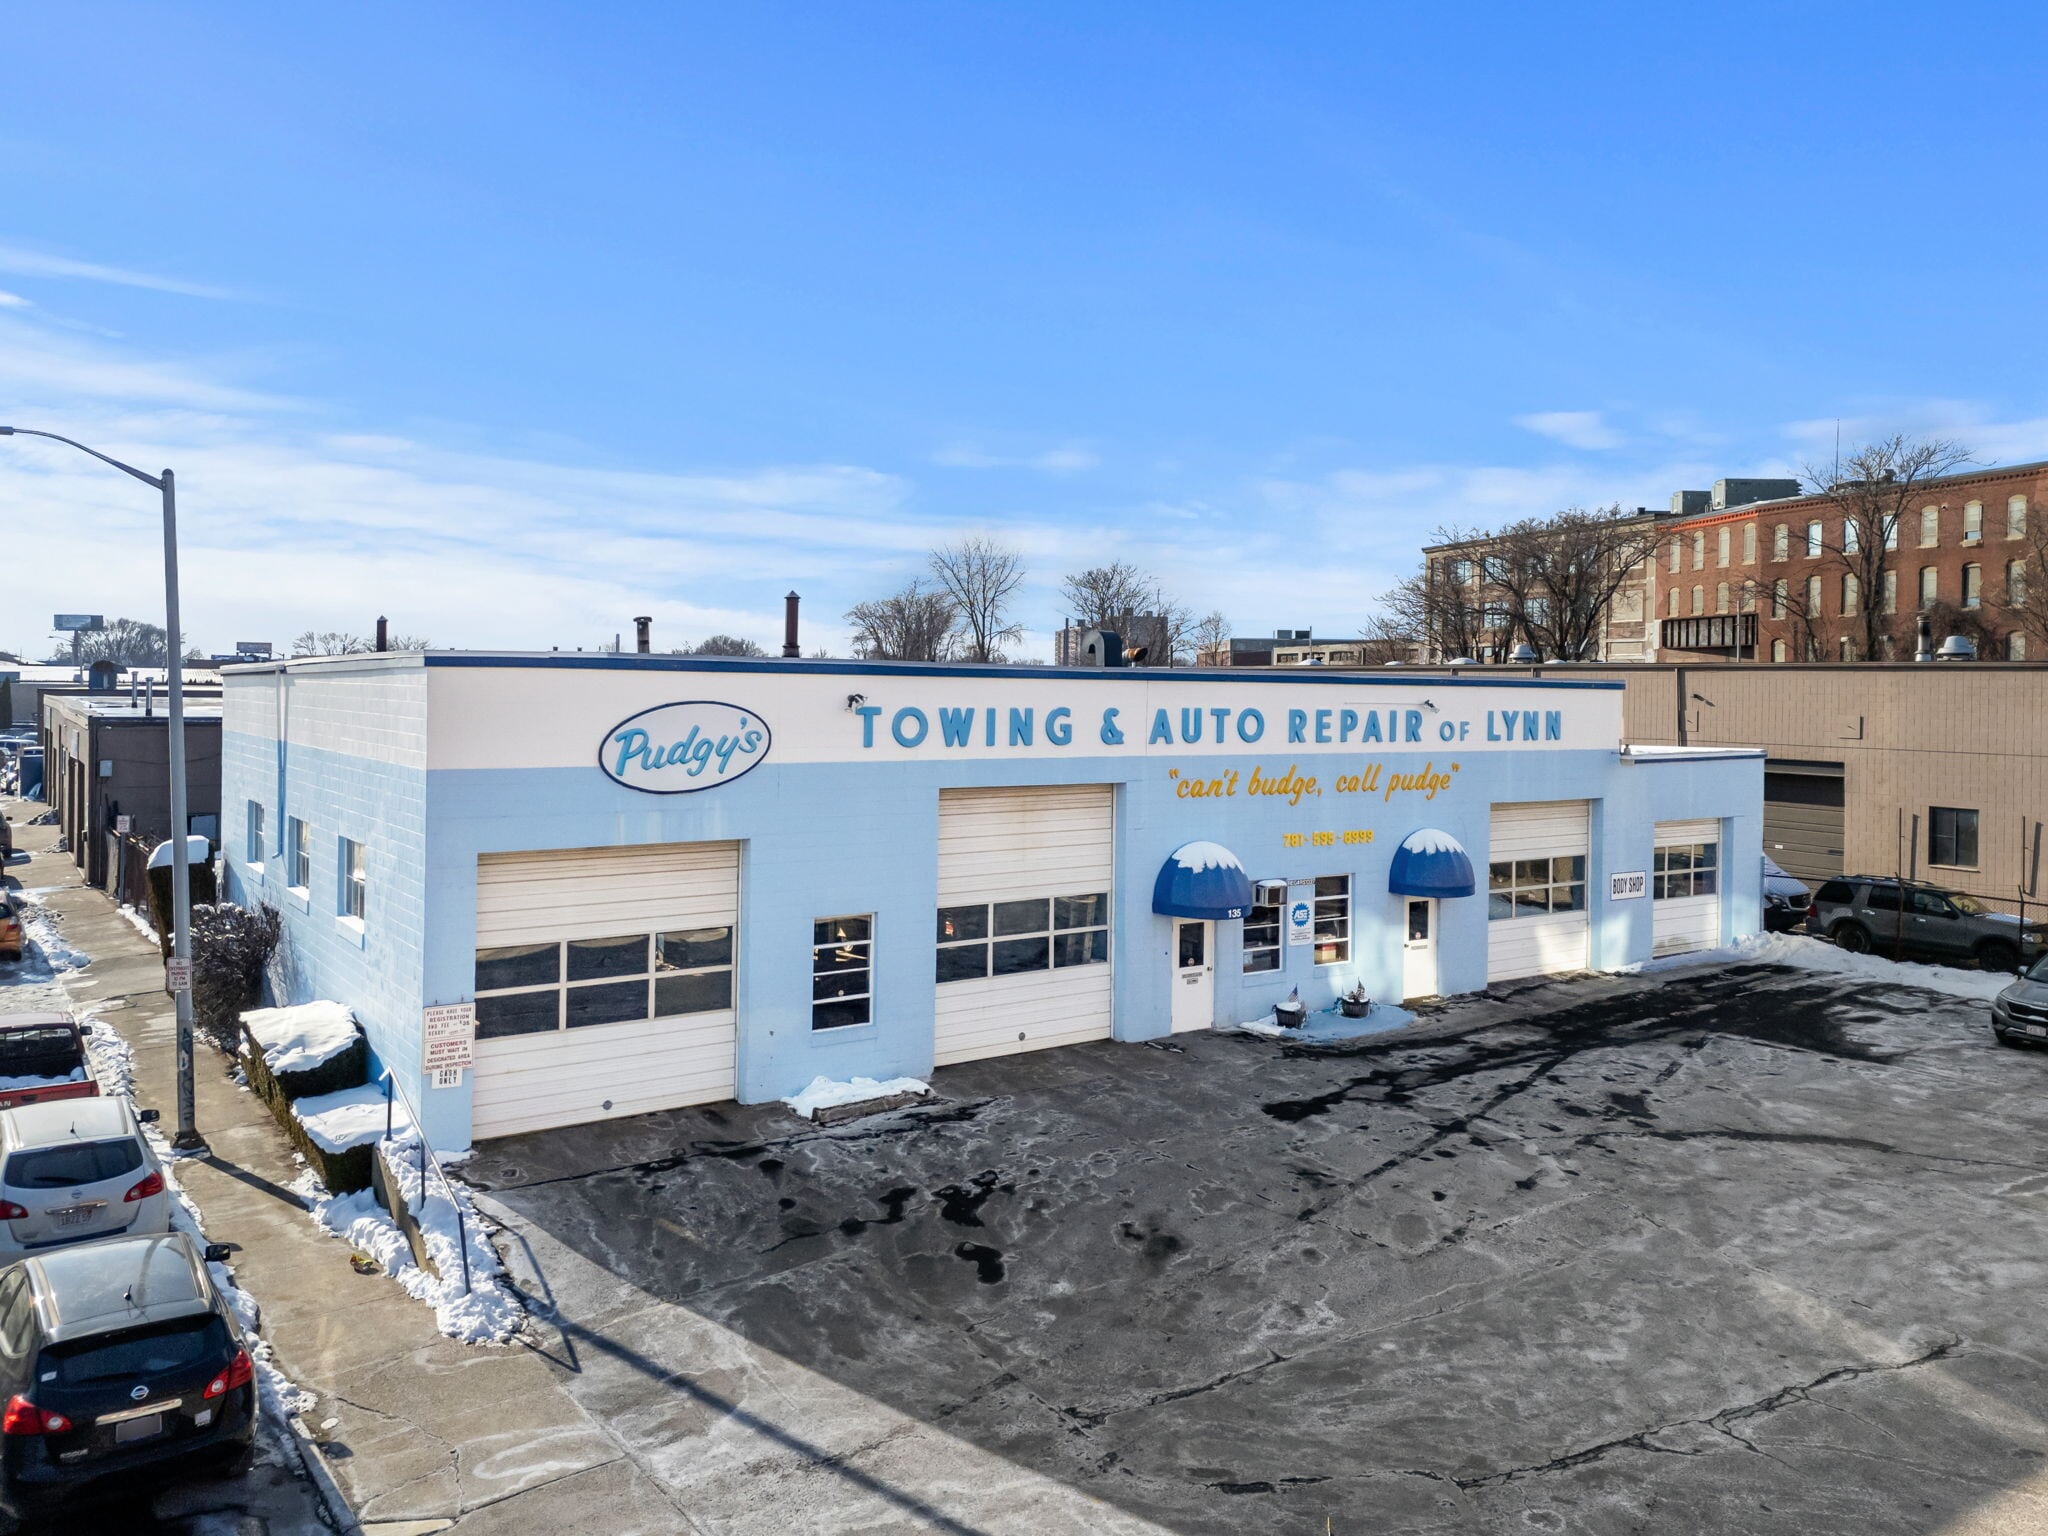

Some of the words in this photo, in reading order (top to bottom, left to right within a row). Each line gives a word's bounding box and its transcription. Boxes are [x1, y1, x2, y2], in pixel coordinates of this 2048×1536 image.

[855, 706, 1073, 748] TOWING
[1100, 707, 1124, 746] &
[1148, 707, 1265, 745] AUTO
[1288, 708, 1423, 744] REPAIR
[1439, 720, 1471, 742] OF
[1487, 710, 1562, 742] LYNN
[614, 716, 763, 777] Pudgy's
[1169, 768, 1239, 798] "can't
[1247, 764, 1323, 806] budge,
[1336, 763, 1383, 792] call
[1384, 761, 1460, 802] pudge"
[1613, 878, 1628, 894] BODY
[1629, 876, 1644, 893] SHOP
[1228, 908, 1242, 918] 135
[1294, 910, 1308, 919] ASE
[430, 1014, 470, 1022] REGISTRATION
[430, 1040, 466, 1049] CUSTOMERS
[426, 1055, 456, 1064] DESIGNATED
[440, 1069, 458, 1077] CASH
